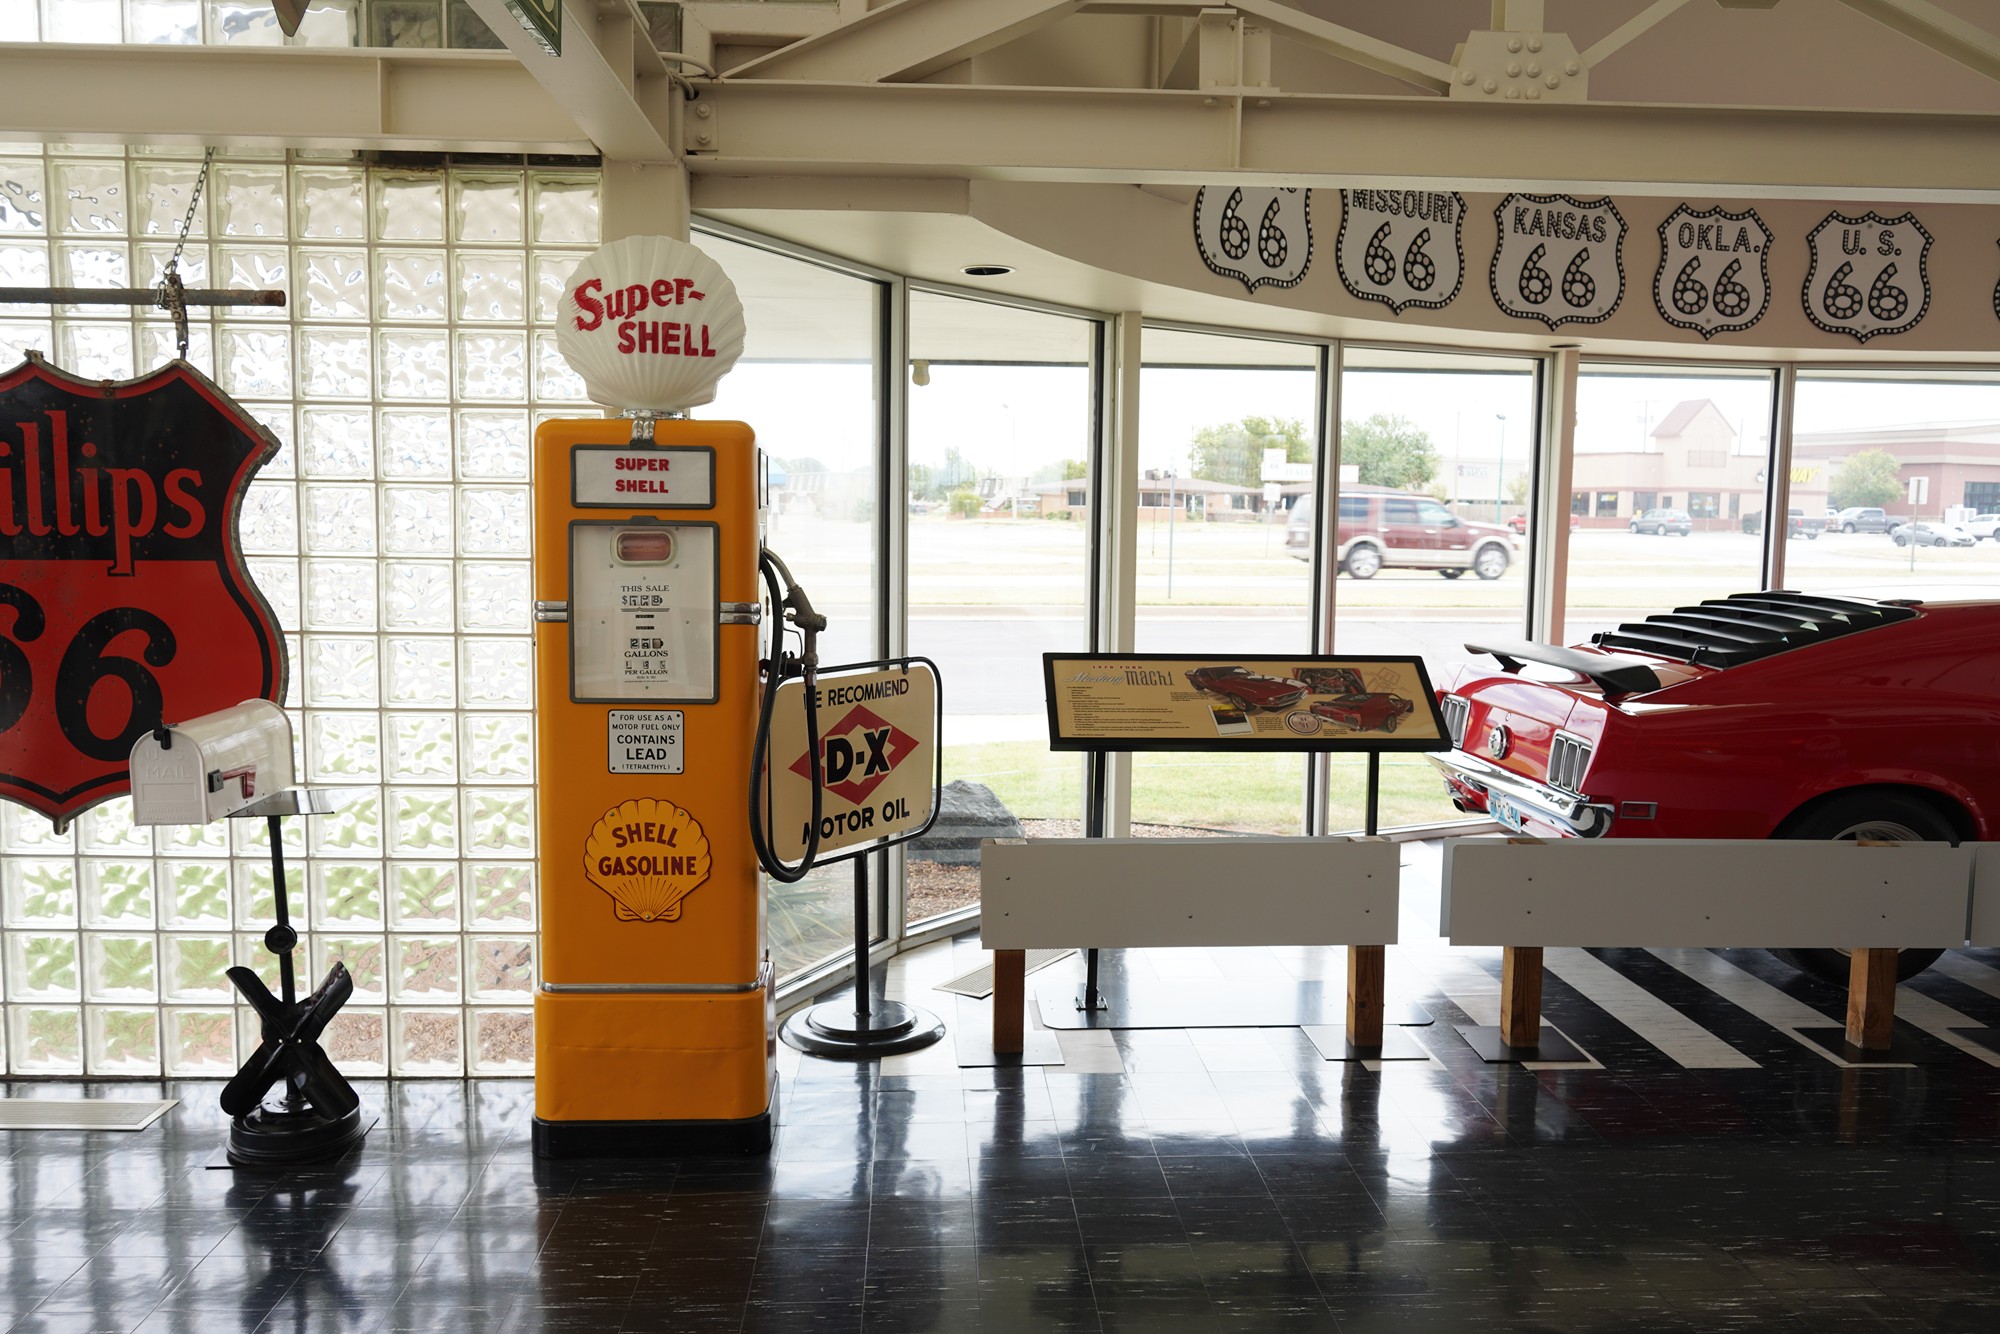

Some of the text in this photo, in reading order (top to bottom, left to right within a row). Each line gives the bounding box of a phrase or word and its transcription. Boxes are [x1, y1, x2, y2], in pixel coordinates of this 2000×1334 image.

[1352, 189, 1454, 224] MISSOURI
[1219, 187, 1288, 269] 66
[1513, 206, 1608, 244] KANSAS
[1678, 222, 1761, 253] OKLA.
[1364, 221, 1436, 292] 66
[1518, 242, 1597, 308] 66
[1672, 255, 1750, 318] 66
[1823, 260, 1909, 321] 66
[617, 321, 716, 357] SHELL
[615, 457, 670, 472] SUPER
[615, 479, 669, 494] SHELL
[624, 650, 669, 658] GALLONS
[828, 678, 909, 707] RECOMMEND
[617, 734, 675, 745] CONTAINS
[626, 747, 667, 760] LEAD
[826, 728, 891, 784] D-X
[145, 765, 194, 779] MAIL
[882, 797, 910, 823] OIL
[611, 822, 678, 848] SHELL
[598, 855, 697, 876] GASOLINE
